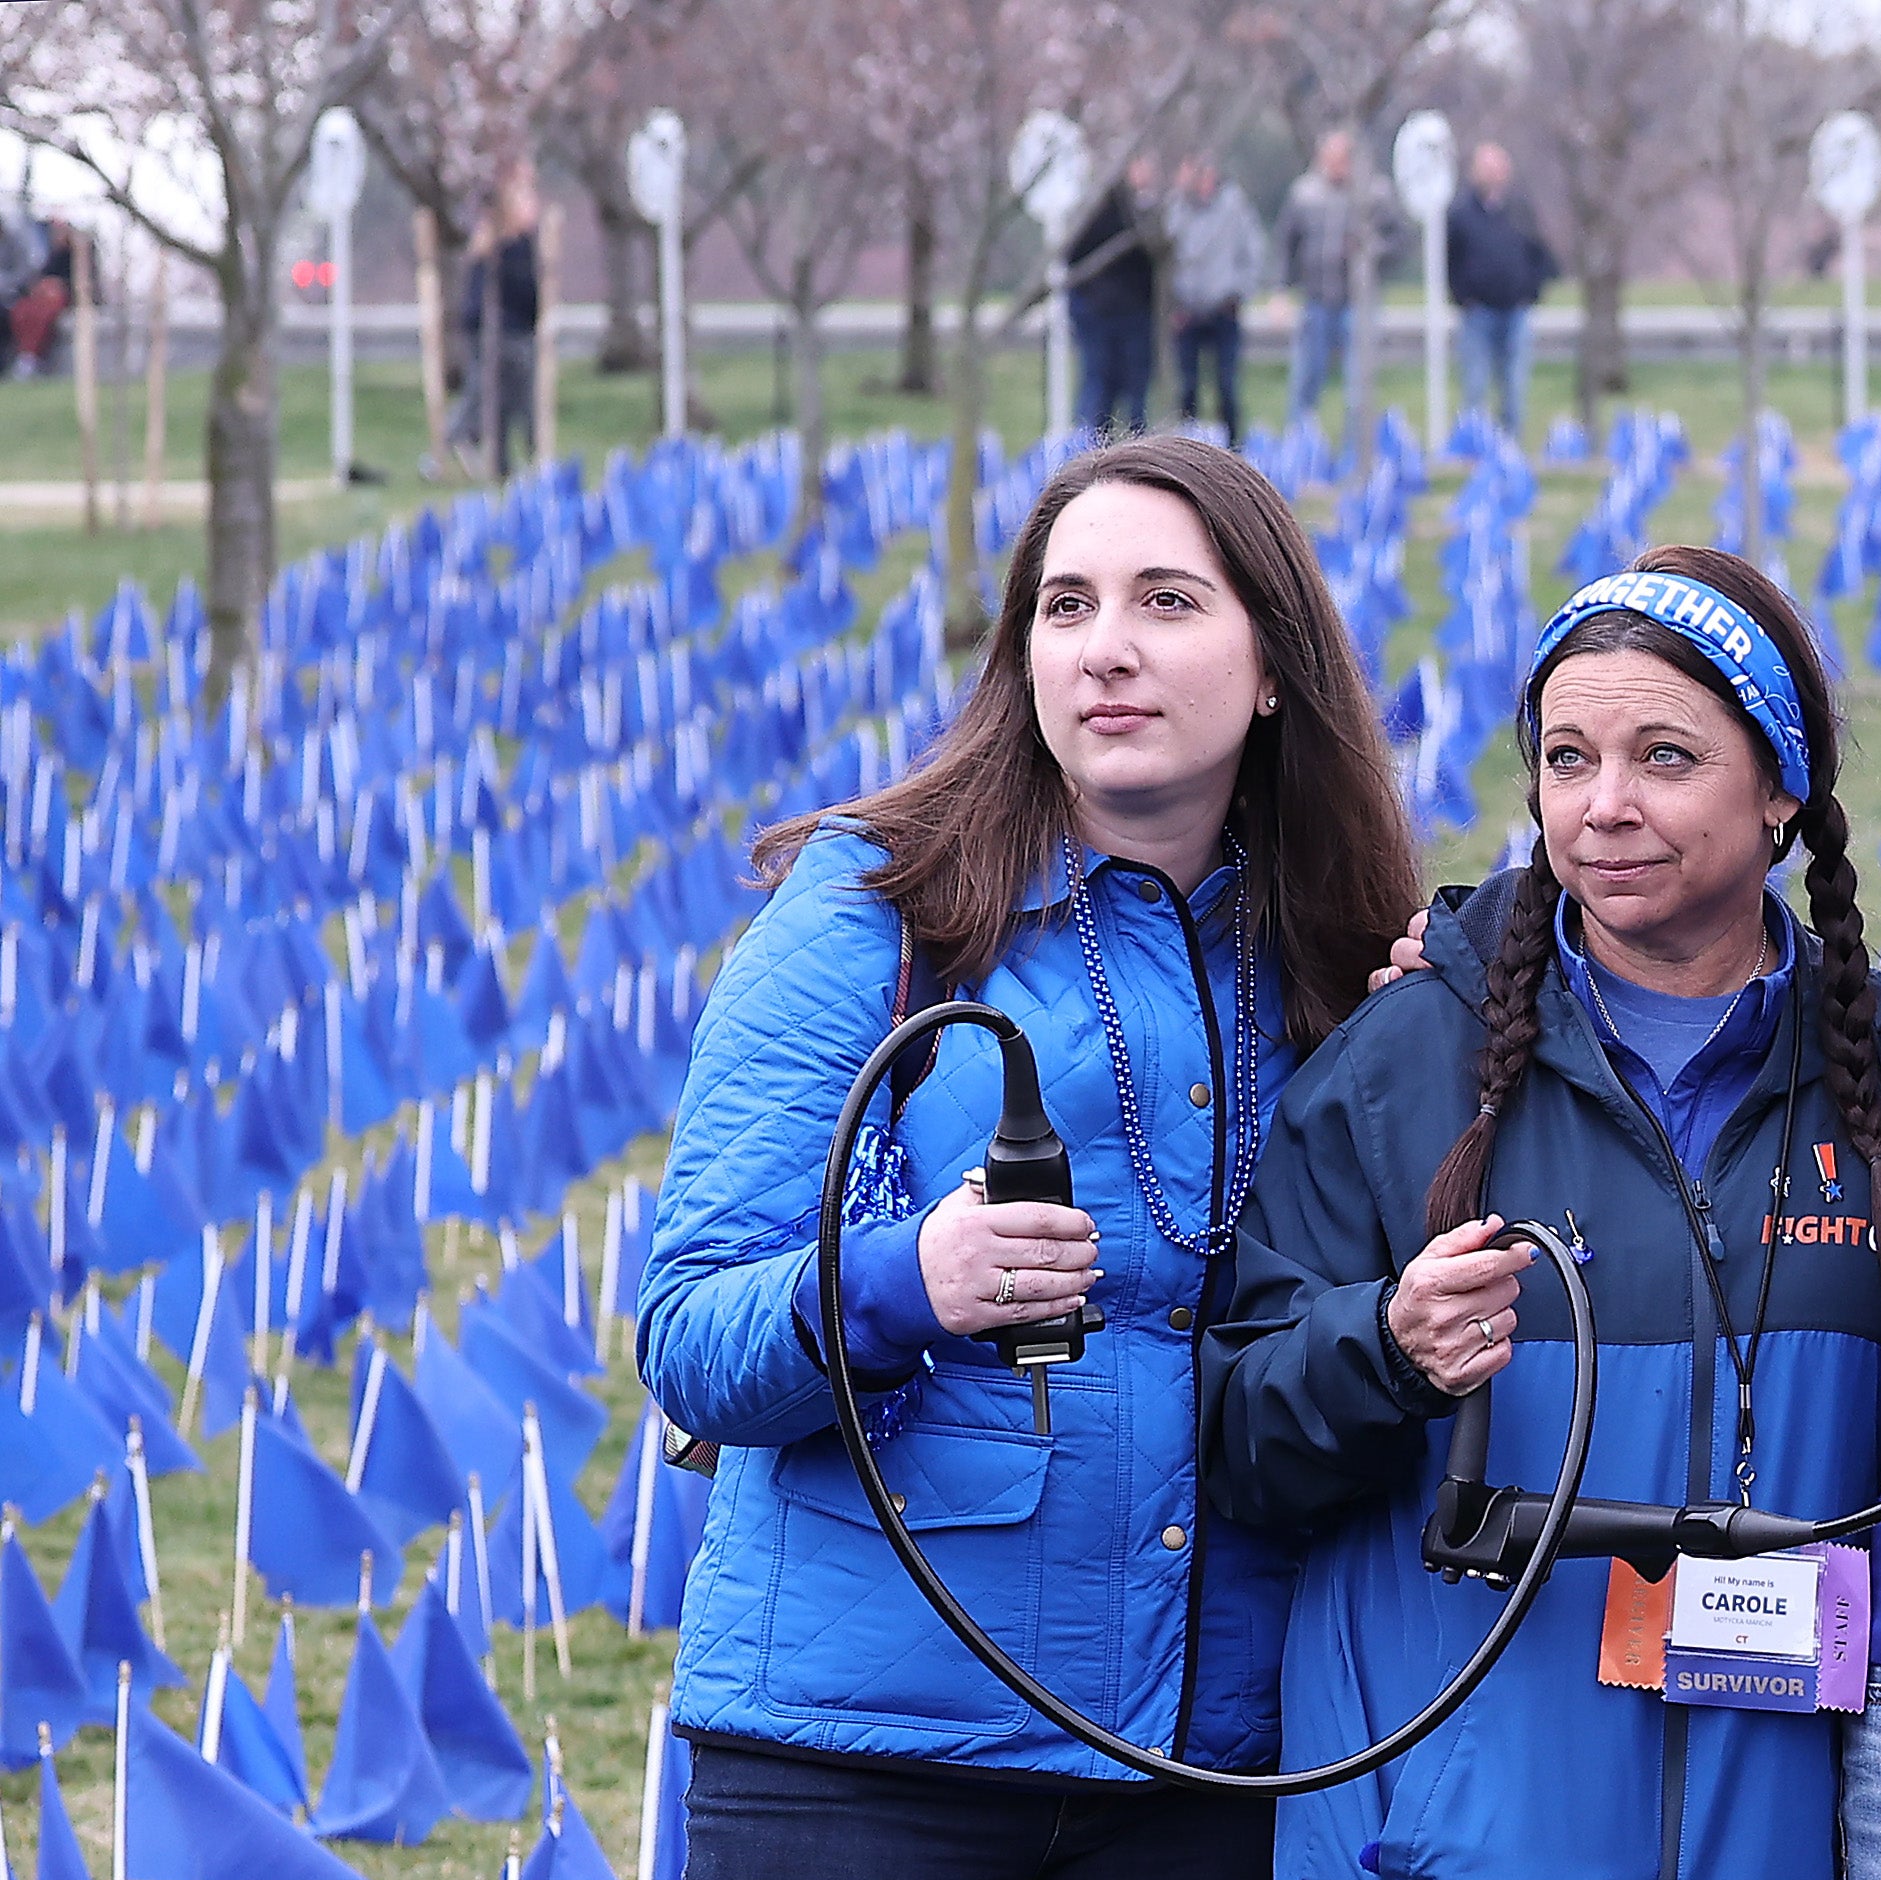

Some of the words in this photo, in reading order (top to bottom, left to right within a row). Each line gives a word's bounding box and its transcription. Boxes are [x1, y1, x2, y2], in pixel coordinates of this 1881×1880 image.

[1728, 1577, 1740, 1586] My
[1742, 1579, 1766, 1588] name
[1767, 1579, 1774, 1588] is
[1701, 1592, 1787, 1615] CAROLE
[1735, 1634, 1749, 1645] CT
[1832, 1594, 1850, 1664] STAFF
[1676, 1671, 1806, 1698] SURVIVOR
